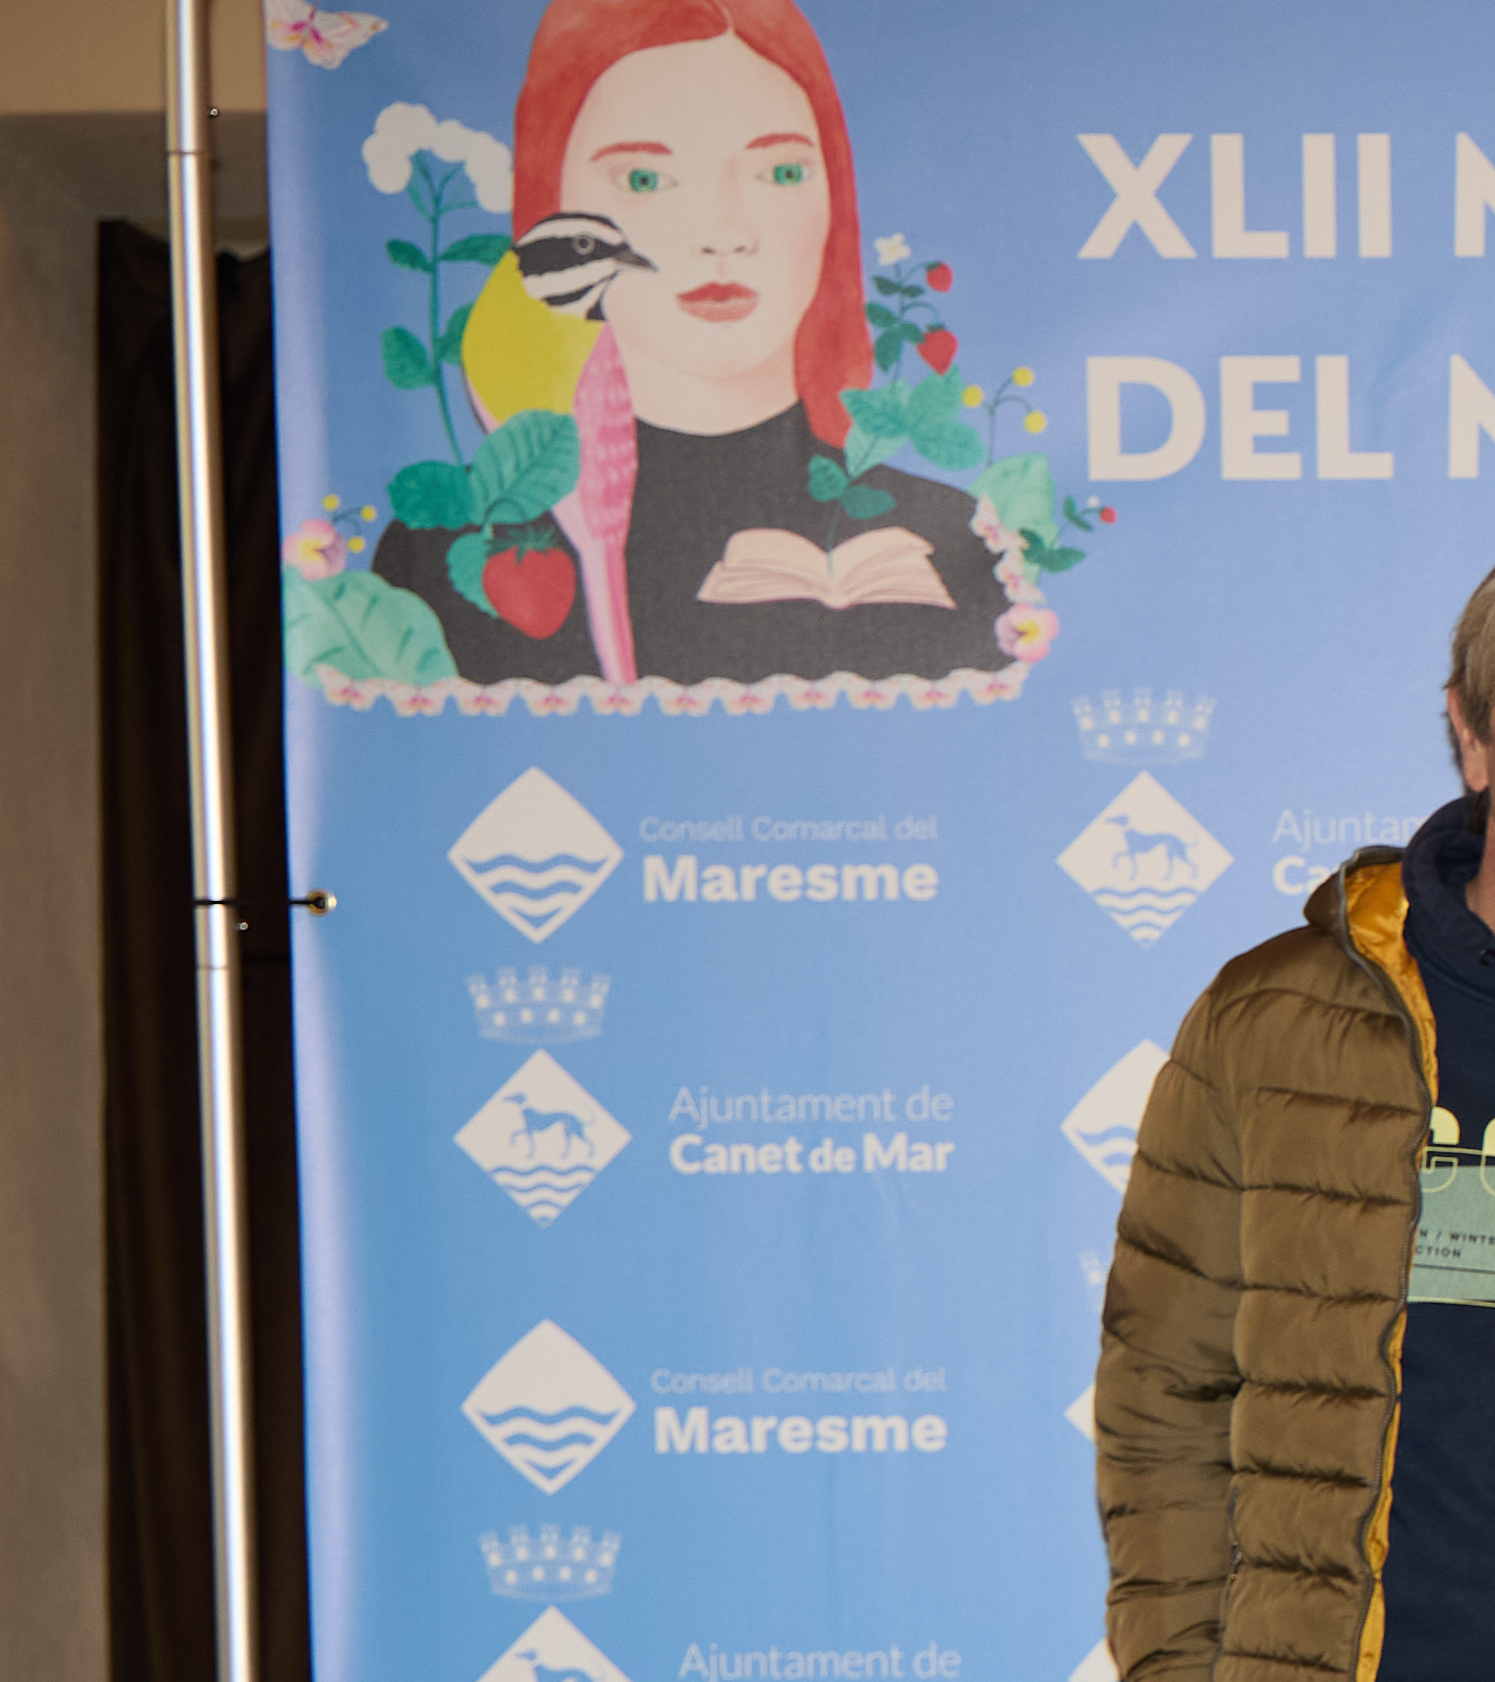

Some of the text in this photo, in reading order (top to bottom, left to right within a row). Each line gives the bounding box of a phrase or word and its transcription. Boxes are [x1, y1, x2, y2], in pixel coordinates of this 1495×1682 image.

[1077, 132, 1392, 258] XLII
[1086, 354, 1394, 481] DEL
[639, 815, 939, 842] Consell Comarcal del
[643, 855, 940, 902] Maresme
[669, 1084, 955, 1131] Ajuntament de
[669, 1132, 955, 1174] Canet de Mar
[650, 1367, 947, 1394] Consell Comarcal del
[654, 1406, 949, 1454] Maresme
[913, 1641, 963, 1680] de
